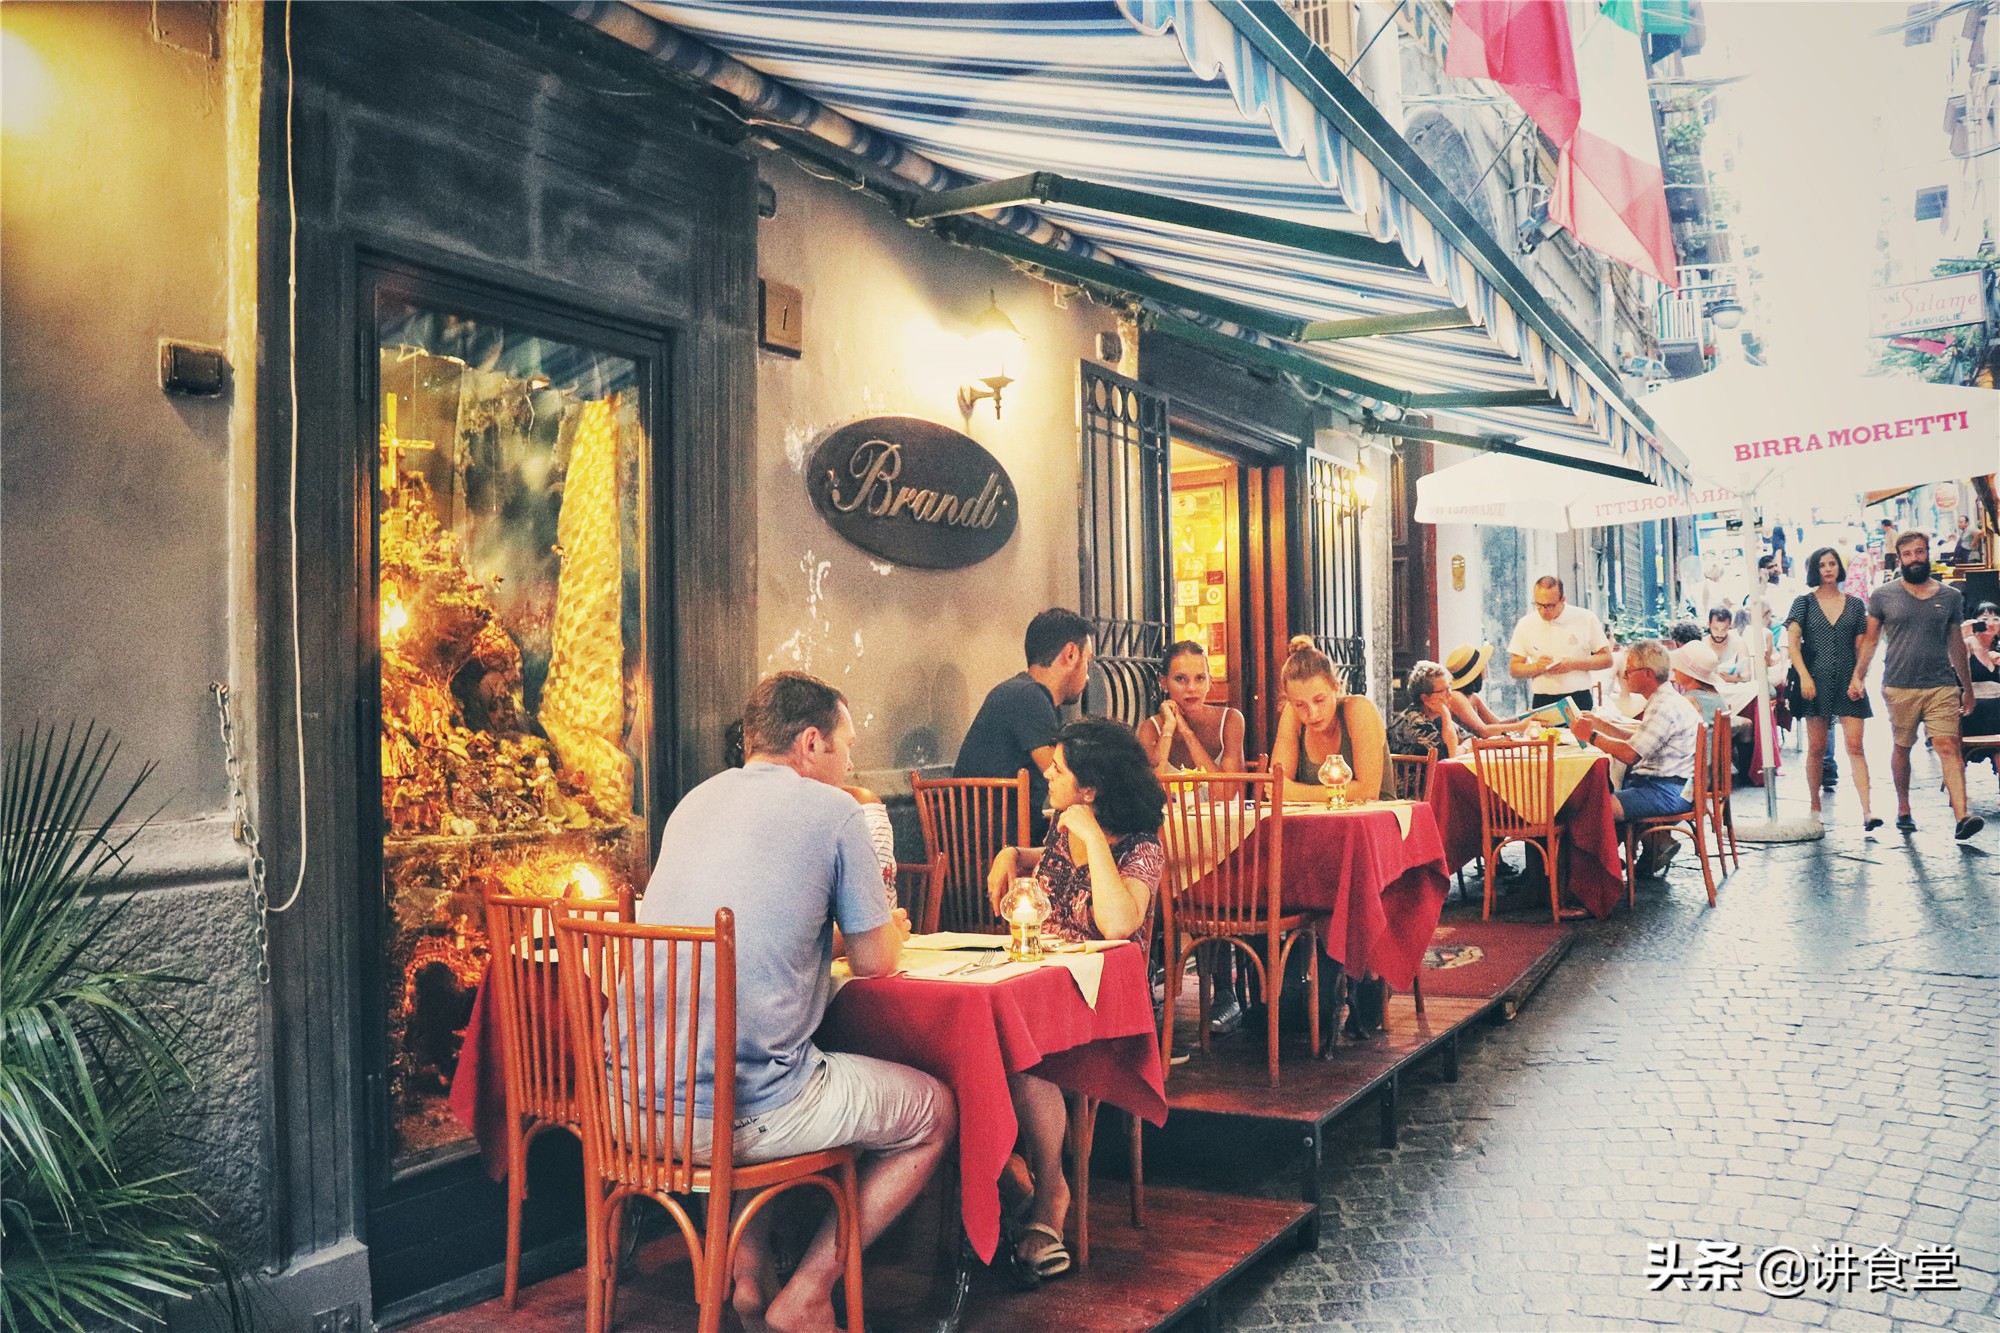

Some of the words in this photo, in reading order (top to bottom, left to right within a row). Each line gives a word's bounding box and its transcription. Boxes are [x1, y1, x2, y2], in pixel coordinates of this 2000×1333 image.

[1880, 287, 1978, 322] Salame
[1900, 312, 1962, 328] MERAVIGLIE
[1733, 433, 1824, 463] BIRRA
[1827, 410, 1970, 449] MORETTI
[831, 439, 1002, 529] Brandi
